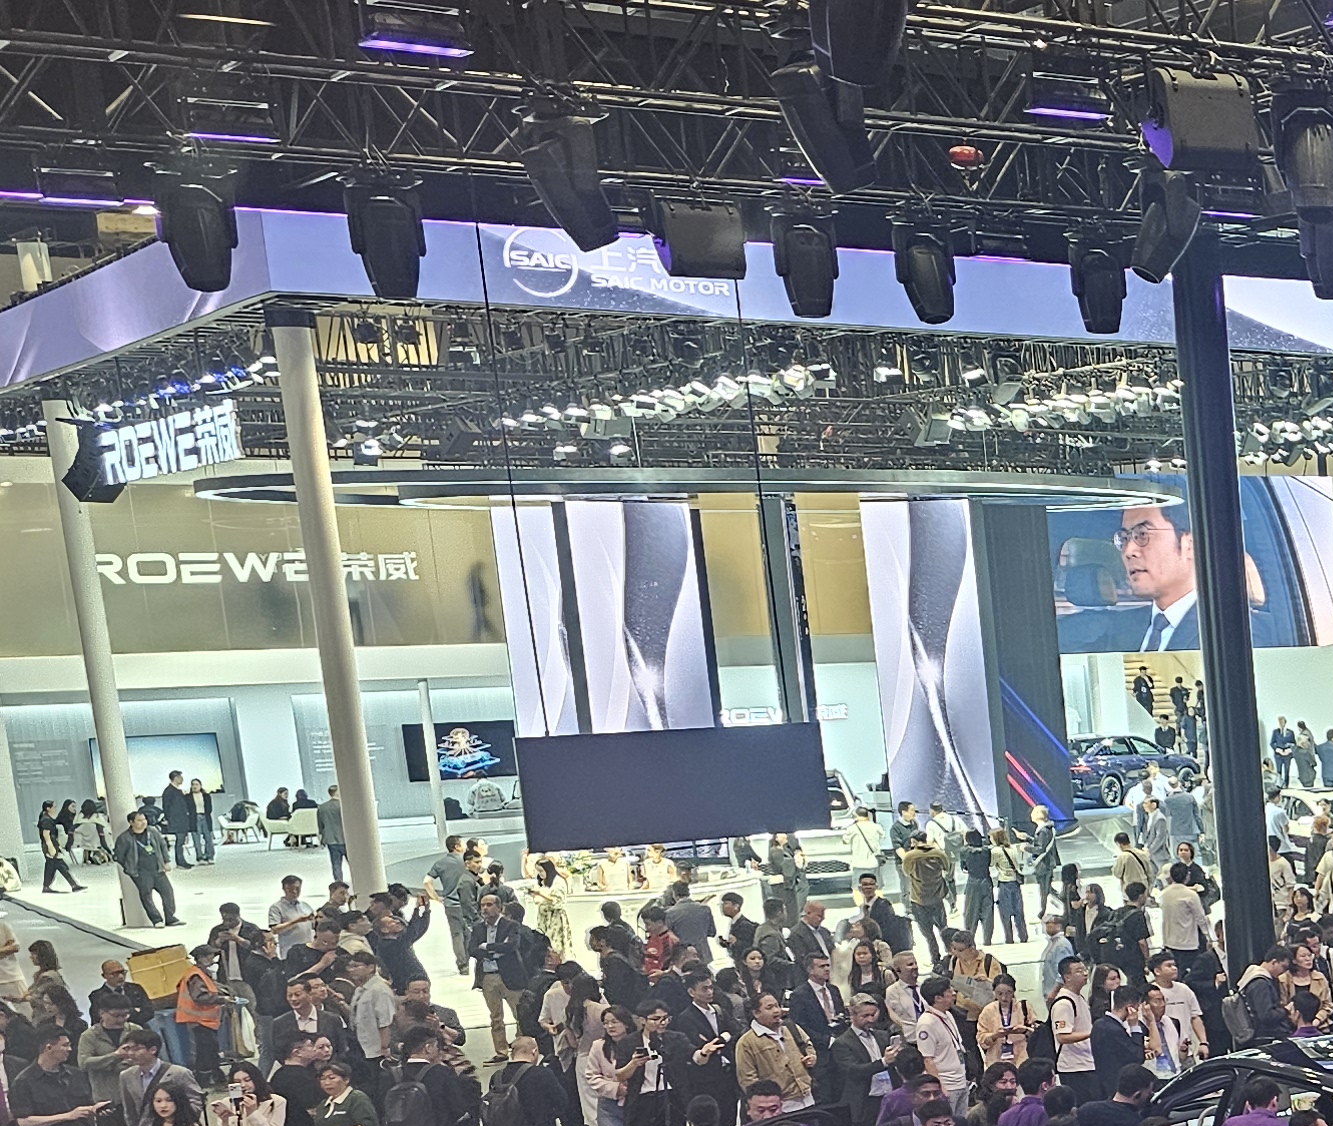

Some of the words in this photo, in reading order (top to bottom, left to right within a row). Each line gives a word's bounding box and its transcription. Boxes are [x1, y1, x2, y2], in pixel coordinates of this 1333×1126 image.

[509, 250, 572, 269] SAIC
[591, 273, 643, 290] SAIC
[649, 277, 731, 296] MOTOR
[100, 411, 199, 486] ROEWE
[195, 399, 243, 467] 荣威
[96, 551, 310, 585] ROEWE
[340, 551, 420, 582] 荣威
